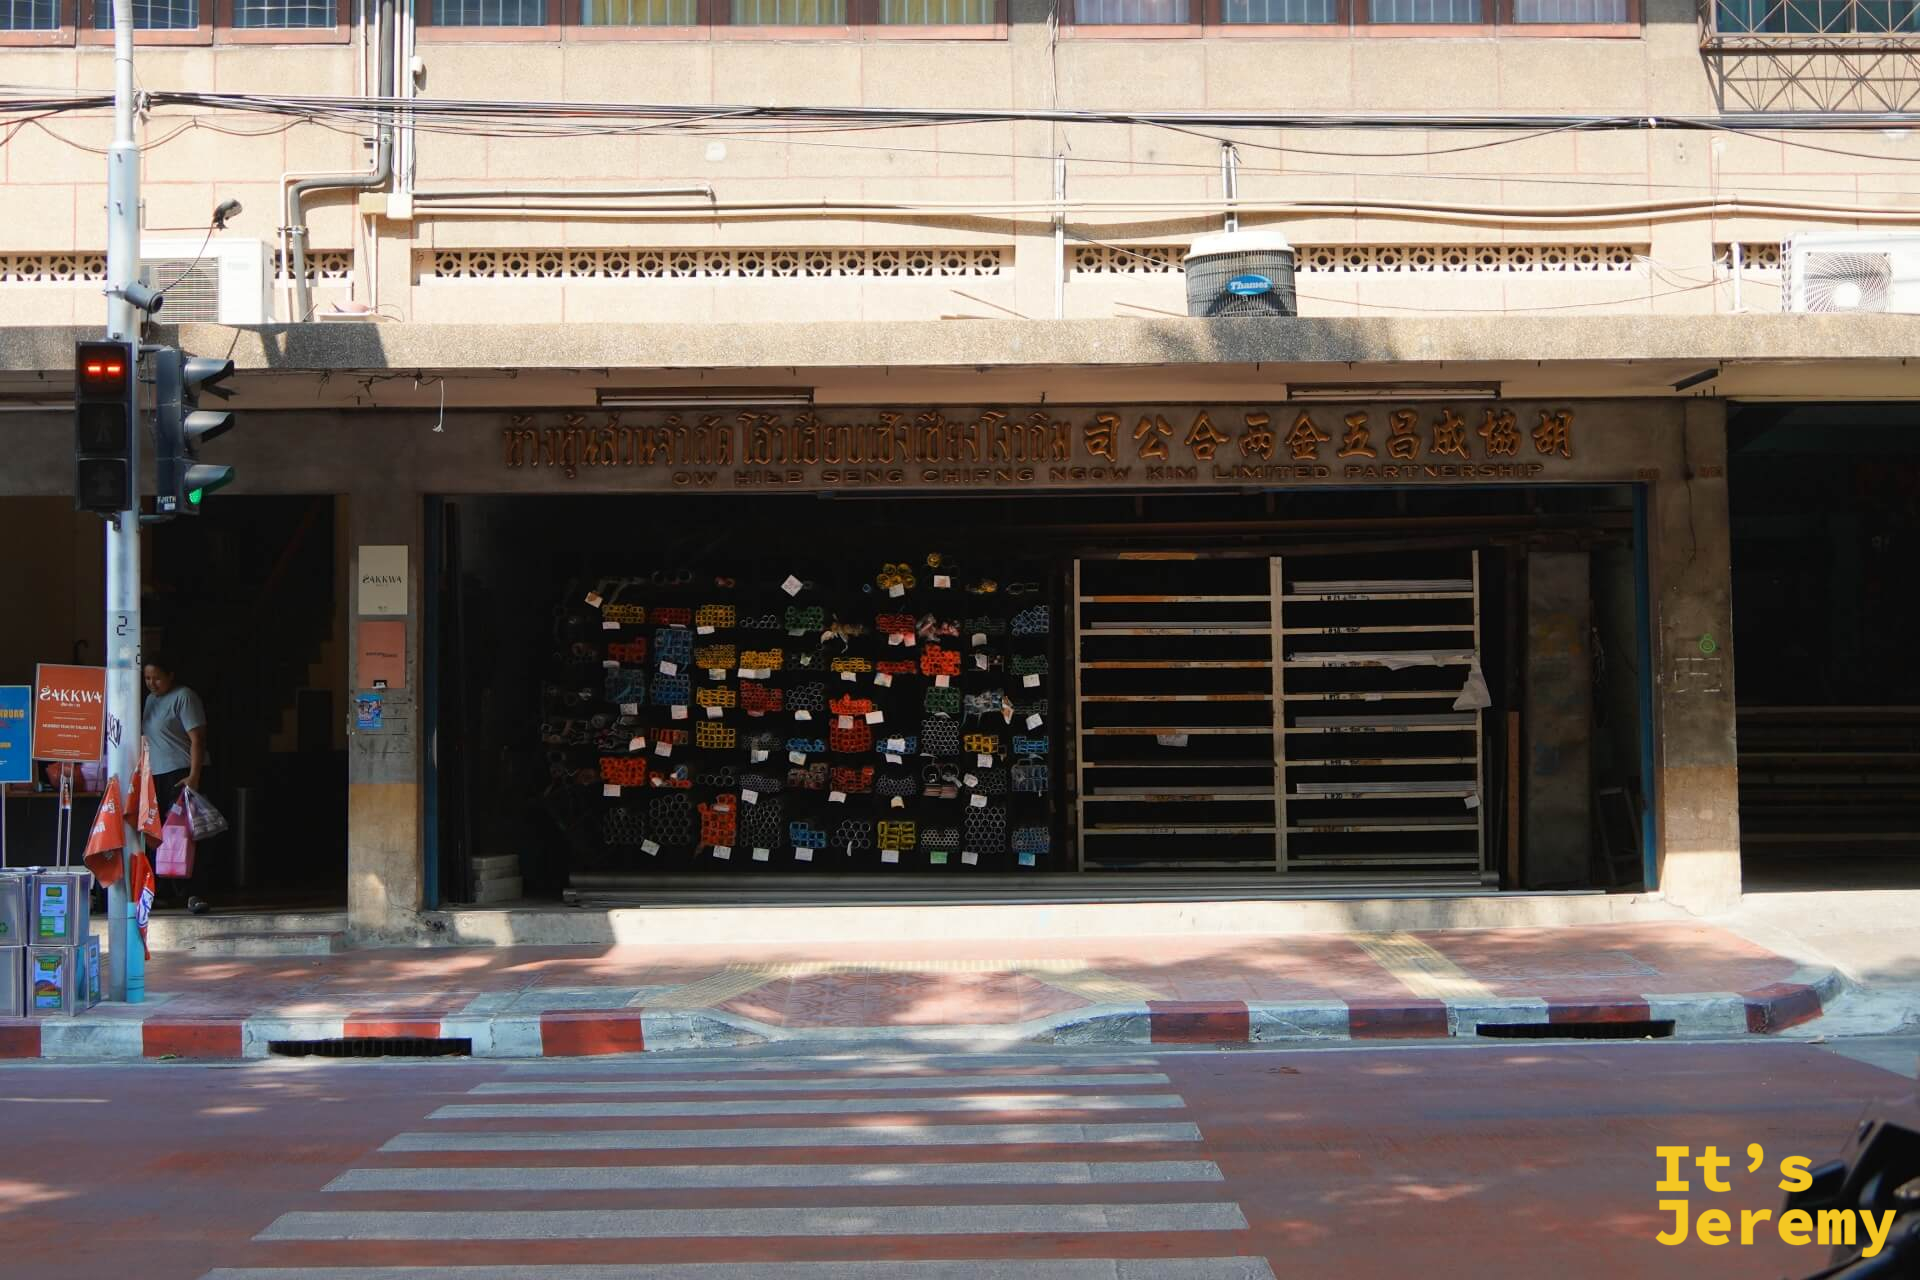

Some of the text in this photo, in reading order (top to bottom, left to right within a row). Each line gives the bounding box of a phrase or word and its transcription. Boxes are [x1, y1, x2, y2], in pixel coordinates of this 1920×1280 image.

[671, 470, 718, 486] OW
[820, 468, 905, 484] SENG
[1048, 466, 1132, 481] NGOW
[1145, 465, 1198, 480] KIM
[1211, 463, 1332, 480] LIMITED
[1343, 462, 1545, 479] PARTNERSHIP
[39, 685, 103, 704] SAKKWA
